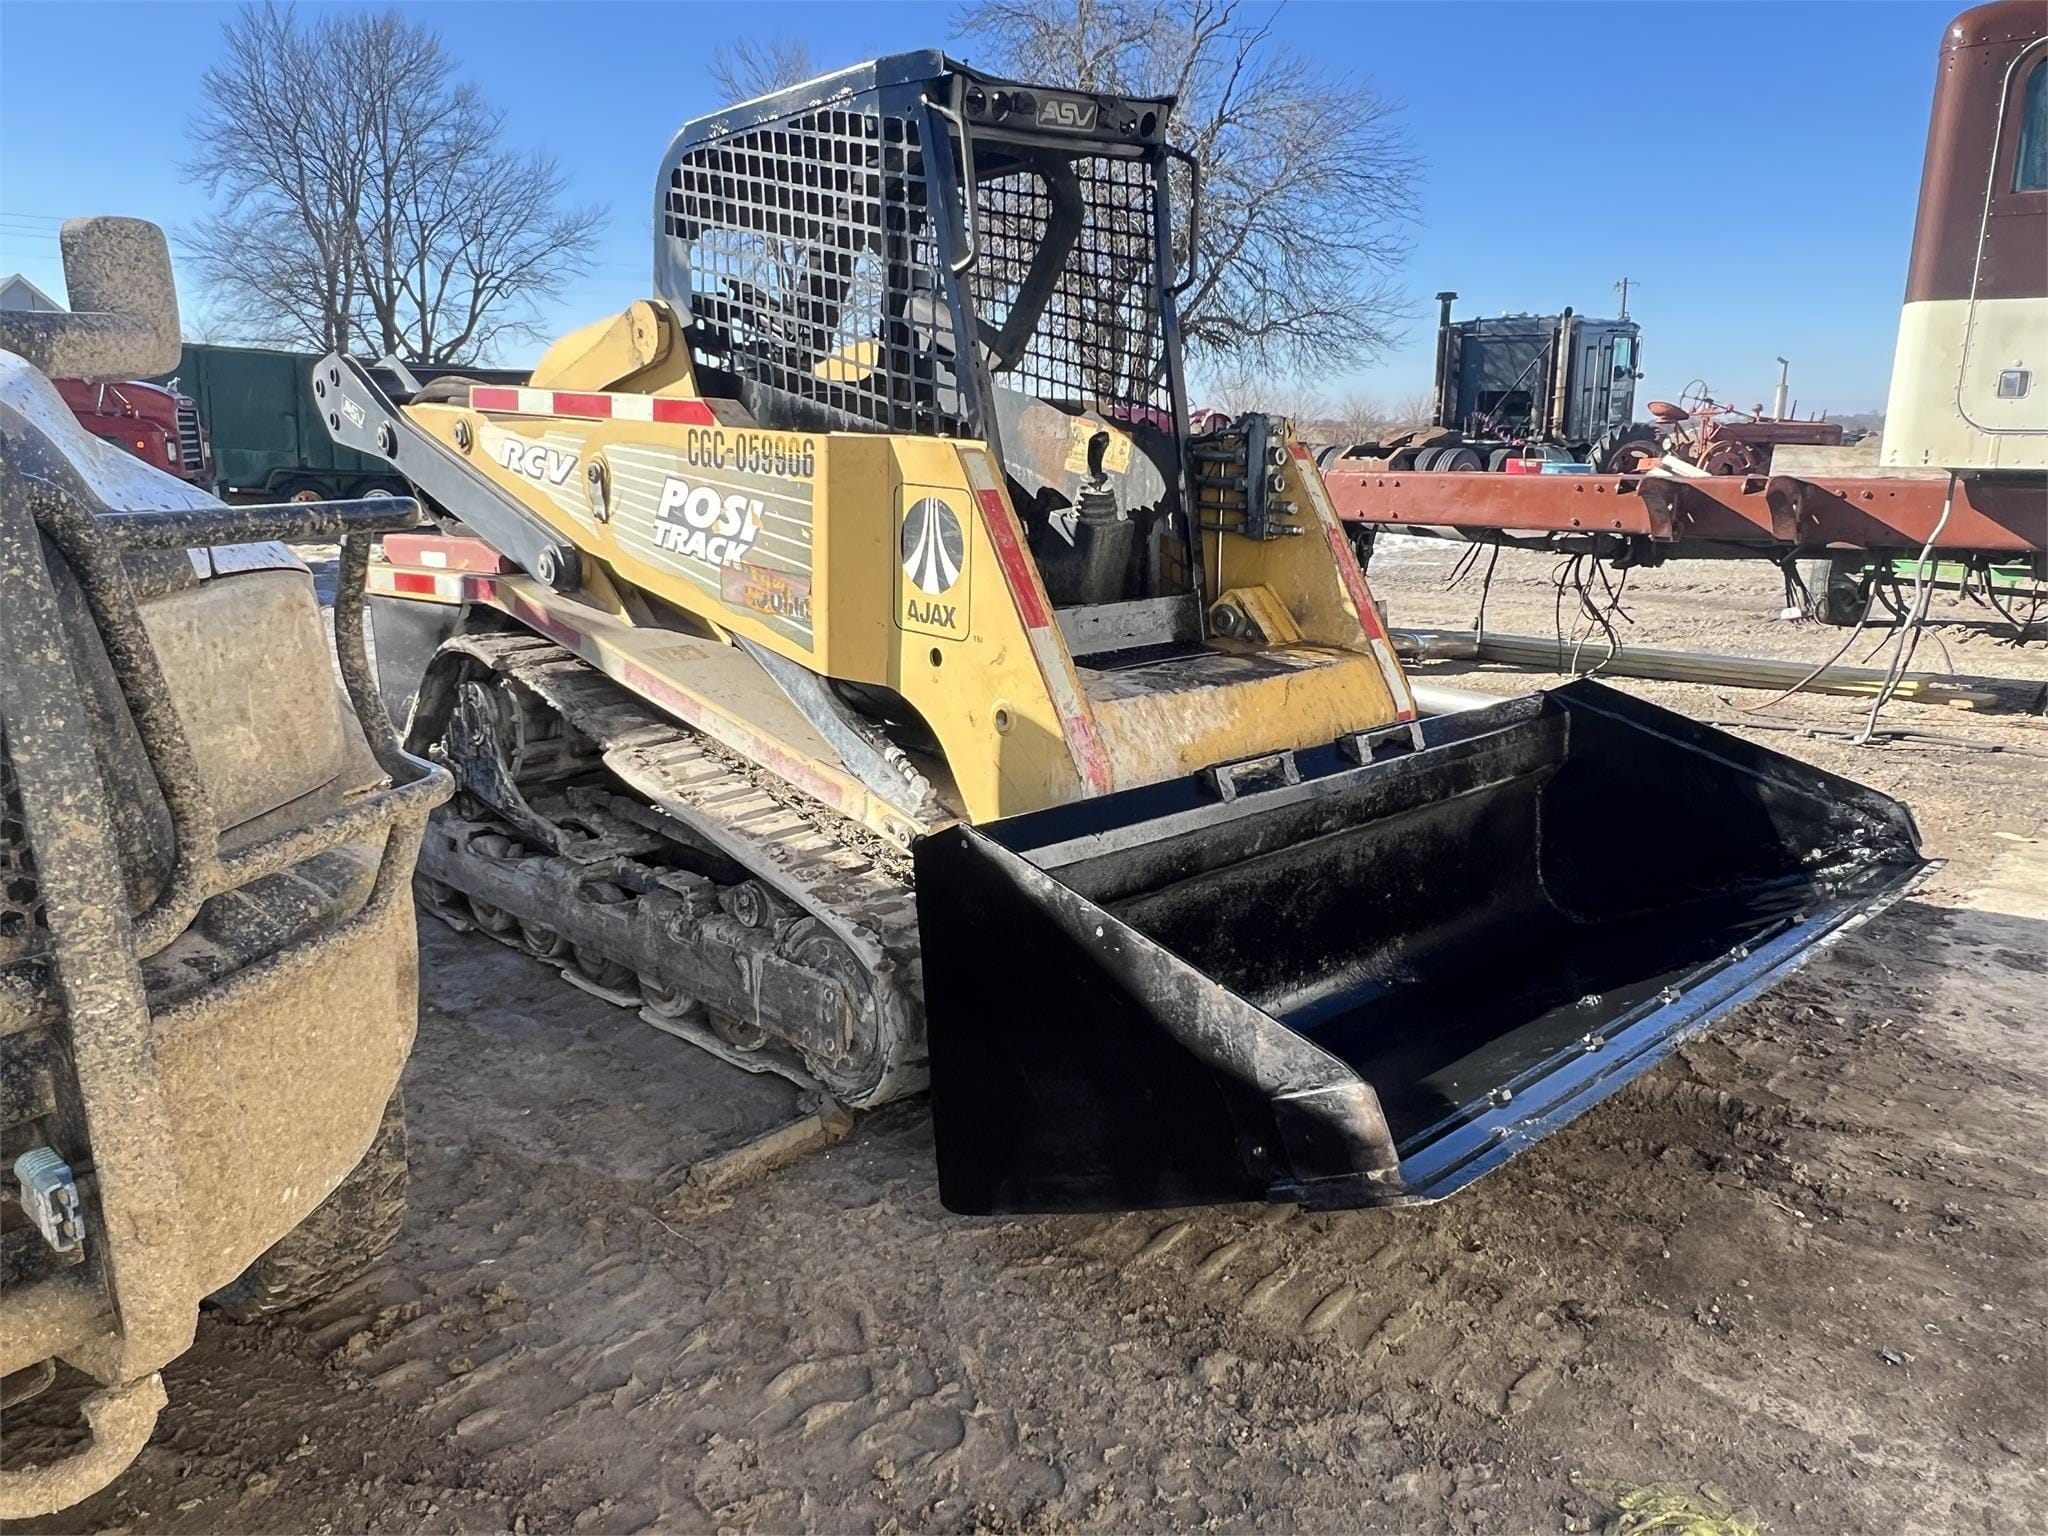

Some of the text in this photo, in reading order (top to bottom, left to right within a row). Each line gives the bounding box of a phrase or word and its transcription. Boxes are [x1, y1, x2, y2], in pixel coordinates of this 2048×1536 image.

[1039, 100, 1097, 127] ASV
[500, 437, 579, 485] RCV
[656, 476, 765, 544] POSI
[654, 519, 751, 571] TRACK
[907, 599, 957, 629] AJAX
